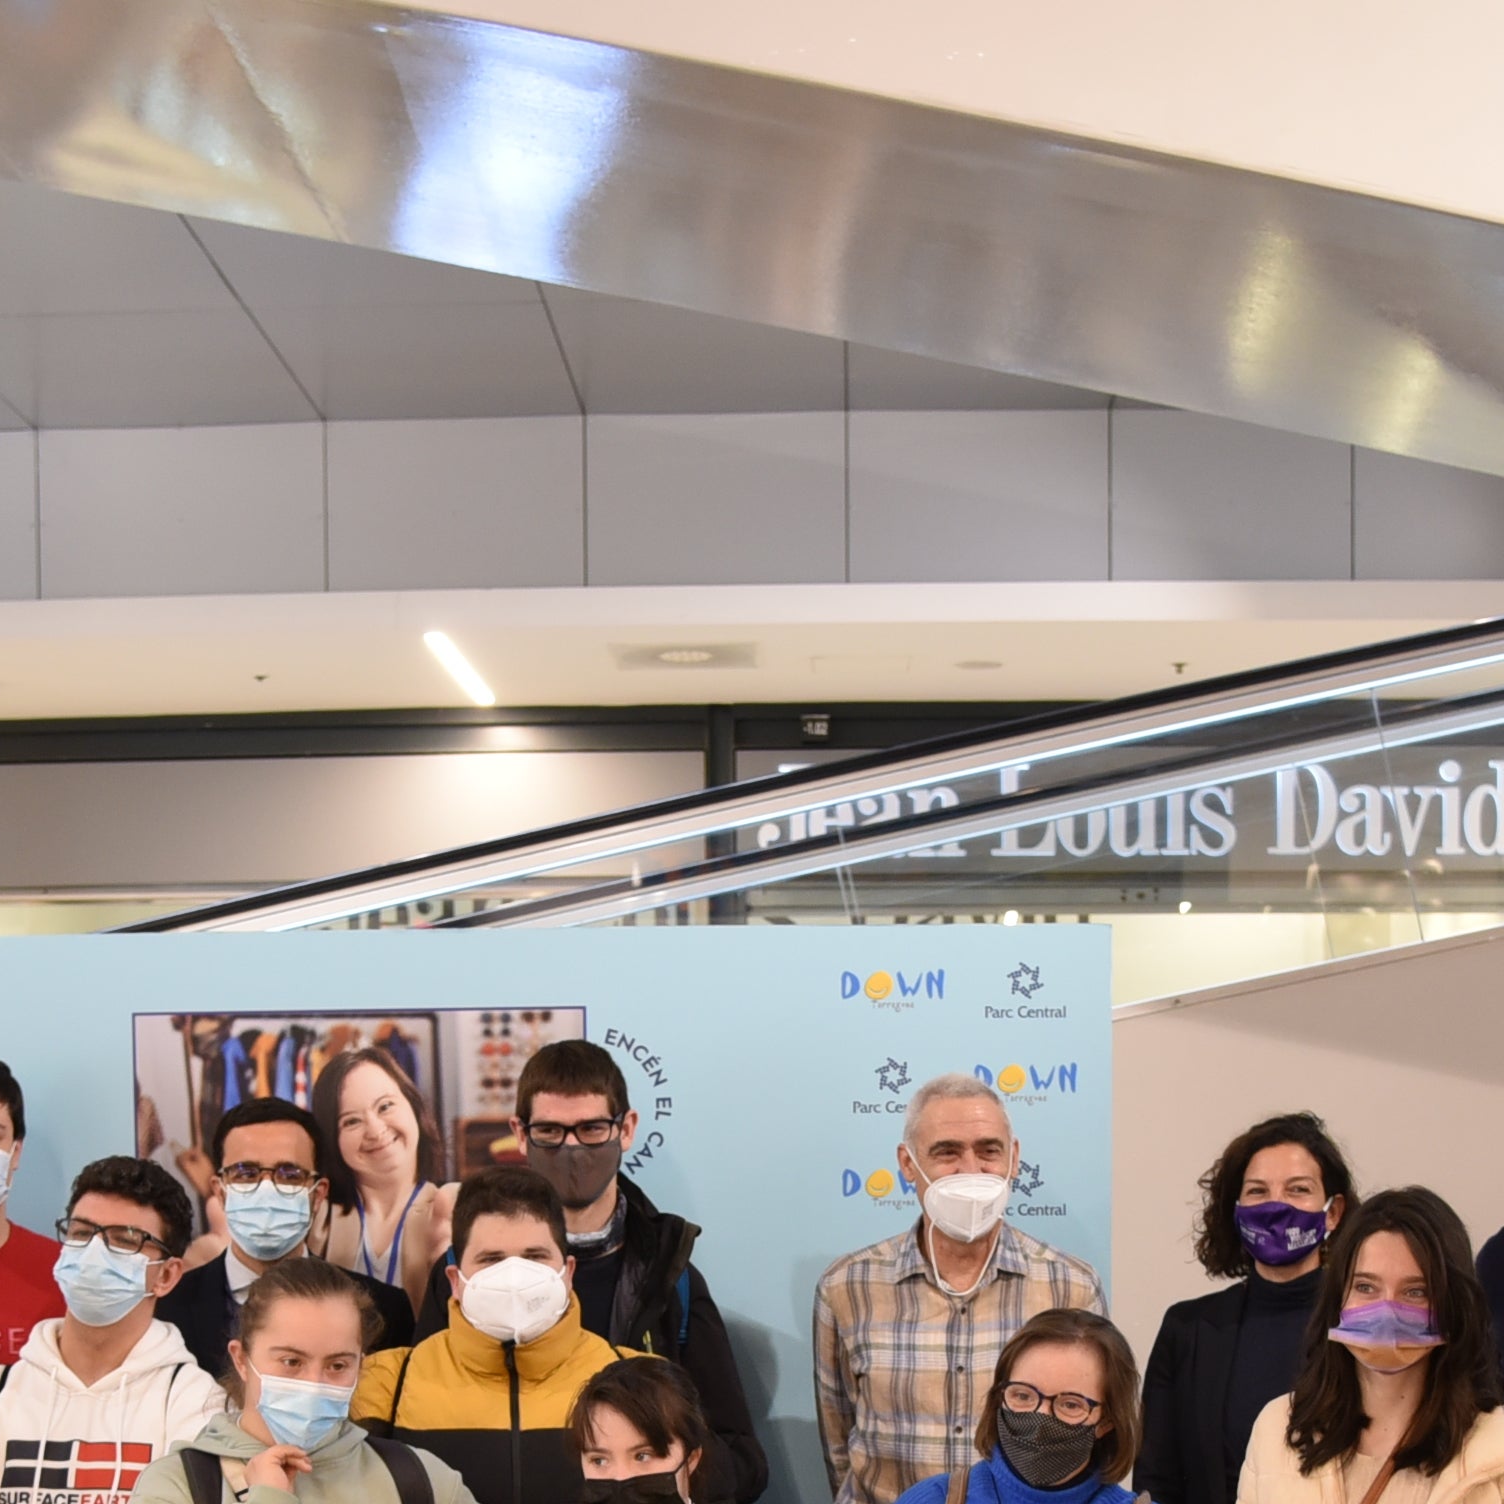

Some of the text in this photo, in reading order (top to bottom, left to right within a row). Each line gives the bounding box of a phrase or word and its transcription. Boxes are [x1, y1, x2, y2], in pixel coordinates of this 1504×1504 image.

[841, 969, 945, 1001] DOWN
[984, 1005, 1067, 1019] Parc Central
[604, 1028, 668, 1087] ENCÉN
[655, 1097, 672, 1120] EL
[974, 1062, 1077, 1094] DOWN
[852, 1101, 881, 1114] Parc
[841, 1168, 917, 1198] DOW
[1017, 1203, 1067, 1217] Central
